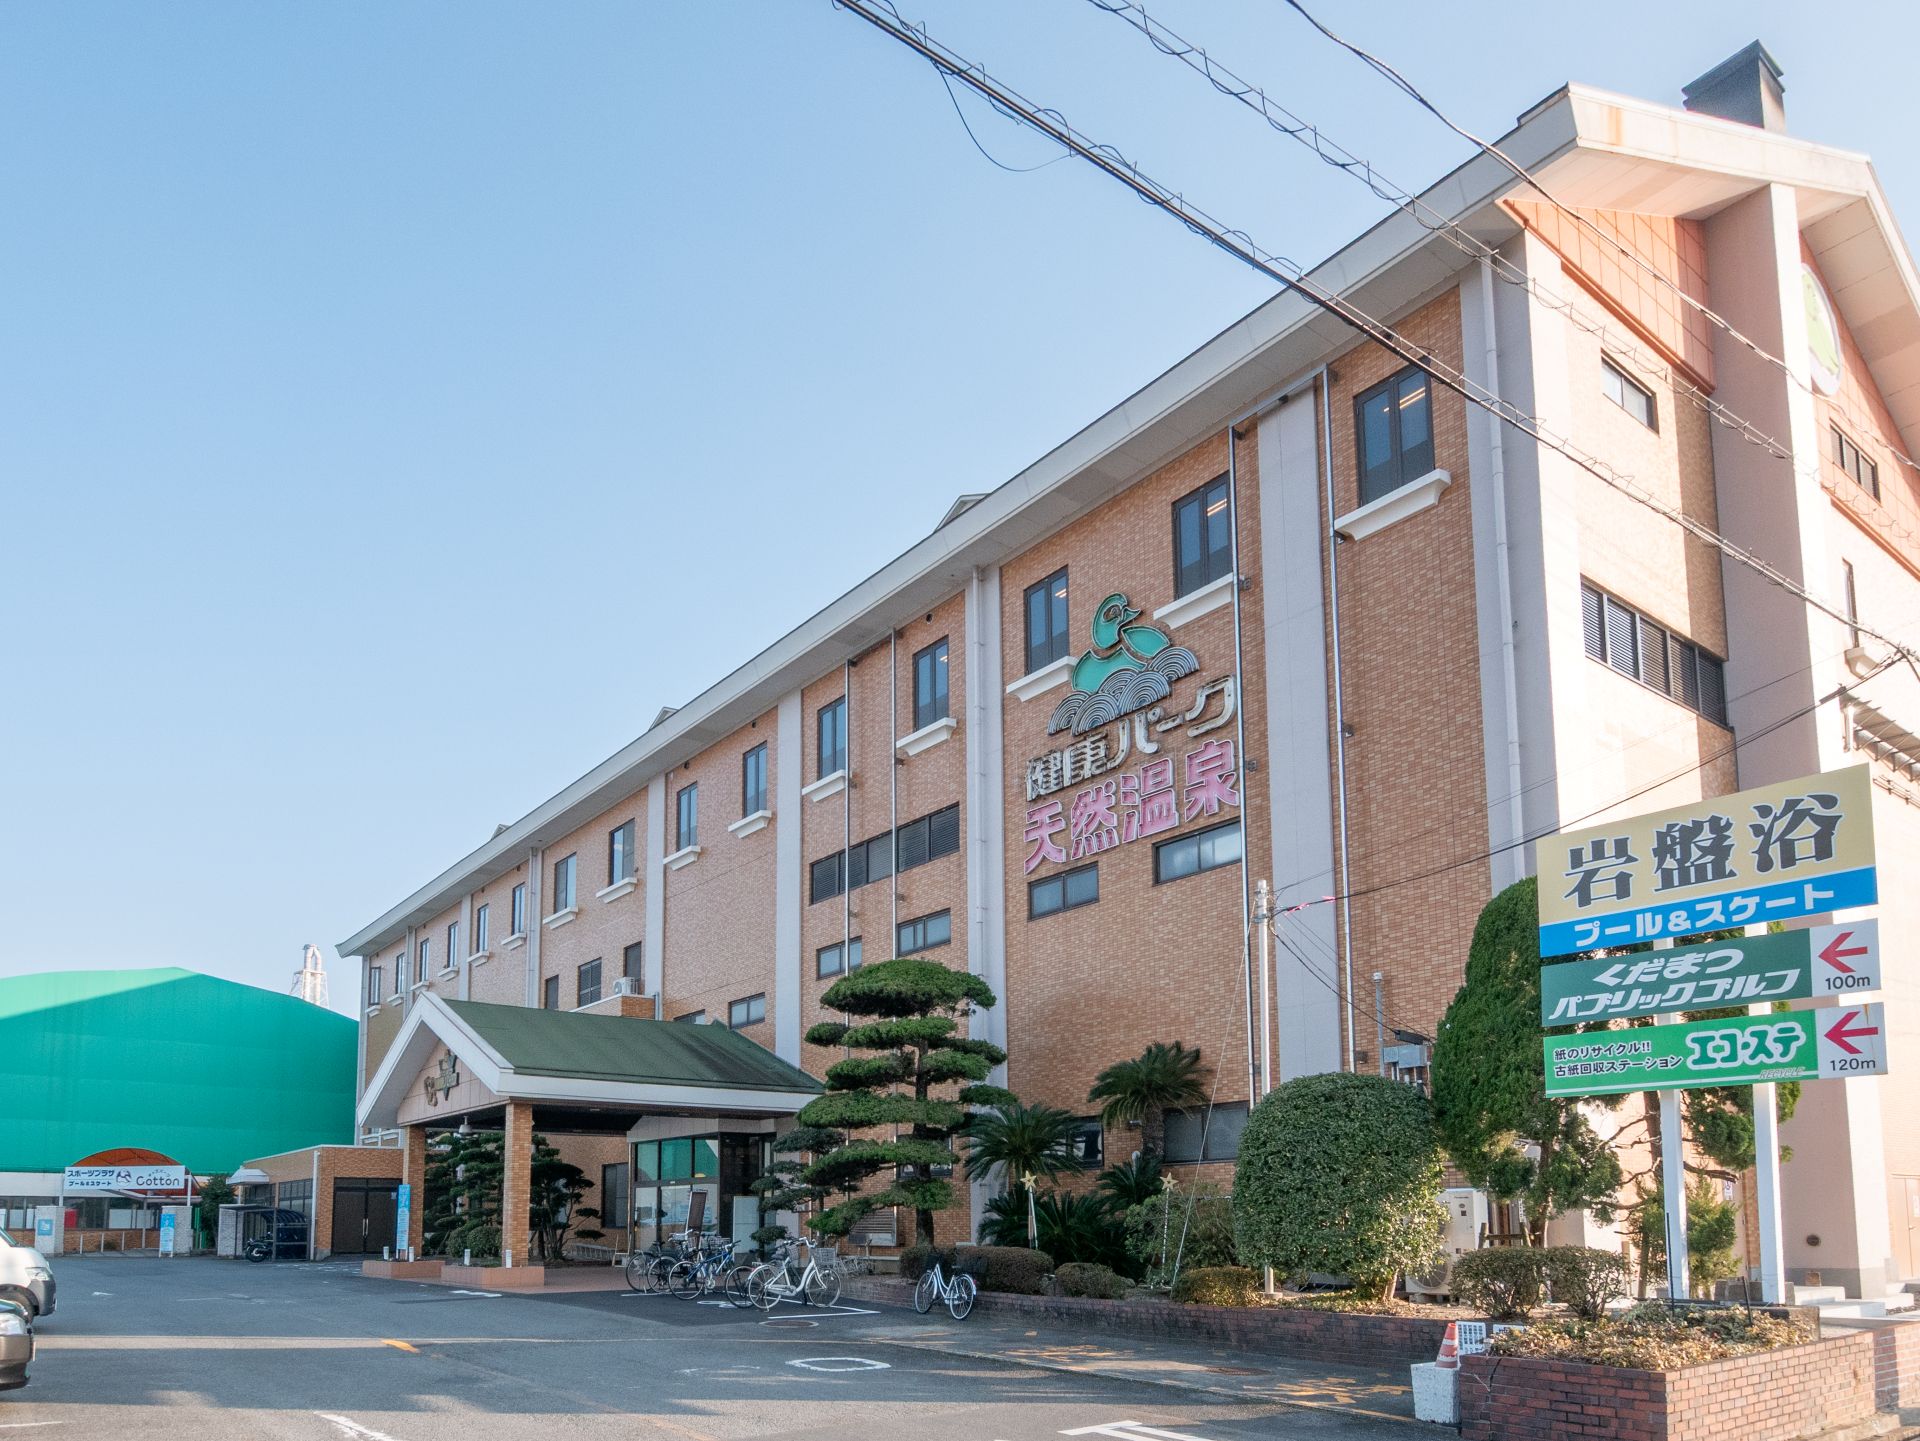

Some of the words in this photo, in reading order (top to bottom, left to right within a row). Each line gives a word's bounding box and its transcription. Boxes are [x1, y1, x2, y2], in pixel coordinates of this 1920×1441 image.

[1024, 739, 1239, 875] 天然温泉
[1562, 793, 1844, 908] 岩盤浴
[1593, 948, 1744, 985] くだまつ
[1825, 974, 1871, 990] 100m
[1549, 968, 1801, 1020] パブリックゴルフ
[1554, 1055, 1683, 1077] 古紙回収ステーション
[1759, 1066, 1805, 1080] RECYCLE
[1830, 1058, 1876, 1072] 120m
[67, 1169, 115, 1178] スポーツプラザ
[136, 1174, 180, 1187] Cotton
